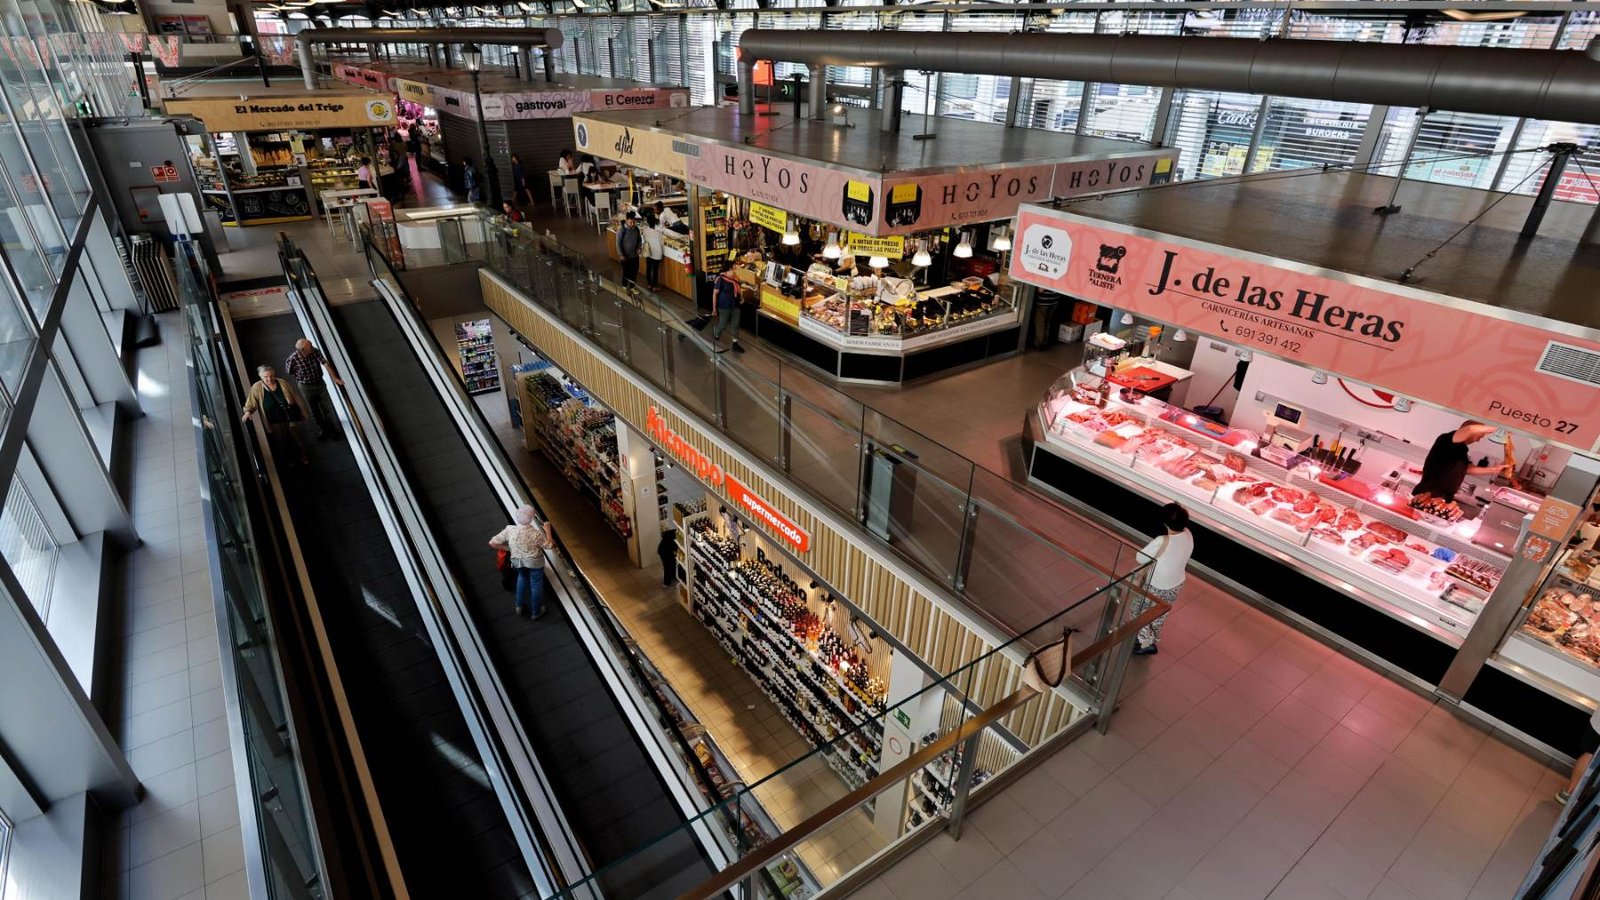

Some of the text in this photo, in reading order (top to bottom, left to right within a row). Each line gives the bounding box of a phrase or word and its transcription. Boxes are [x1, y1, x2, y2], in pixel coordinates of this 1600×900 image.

[235, 103, 344, 114] El Mercado del Trigo
[516, 100, 567, 112] gastroval
[605, 94, 614, 105] El
[1305, 128, 1350, 139] BURGERS
[725, 154, 808, 194] HOYOS
[942, 174, 1038, 205] HOYOS
[1069, 162, 1145, 189] HOYOS
[1088, 268, 1122, 285] TERNERA
[1148, 250, 1405, 344] J. de las Heras
[1201, 301, 1315, 339] CARNICERÍAS ARTESANAS
[1235, 325, 1301, 354] 691 391 412
[1488, 400, 1580, 435] Puesto 27
[647, 405, 724, 487] Alcampo
[742, 493, 802, 545] supermercado
[757, 546, 807, 604] Bodega
